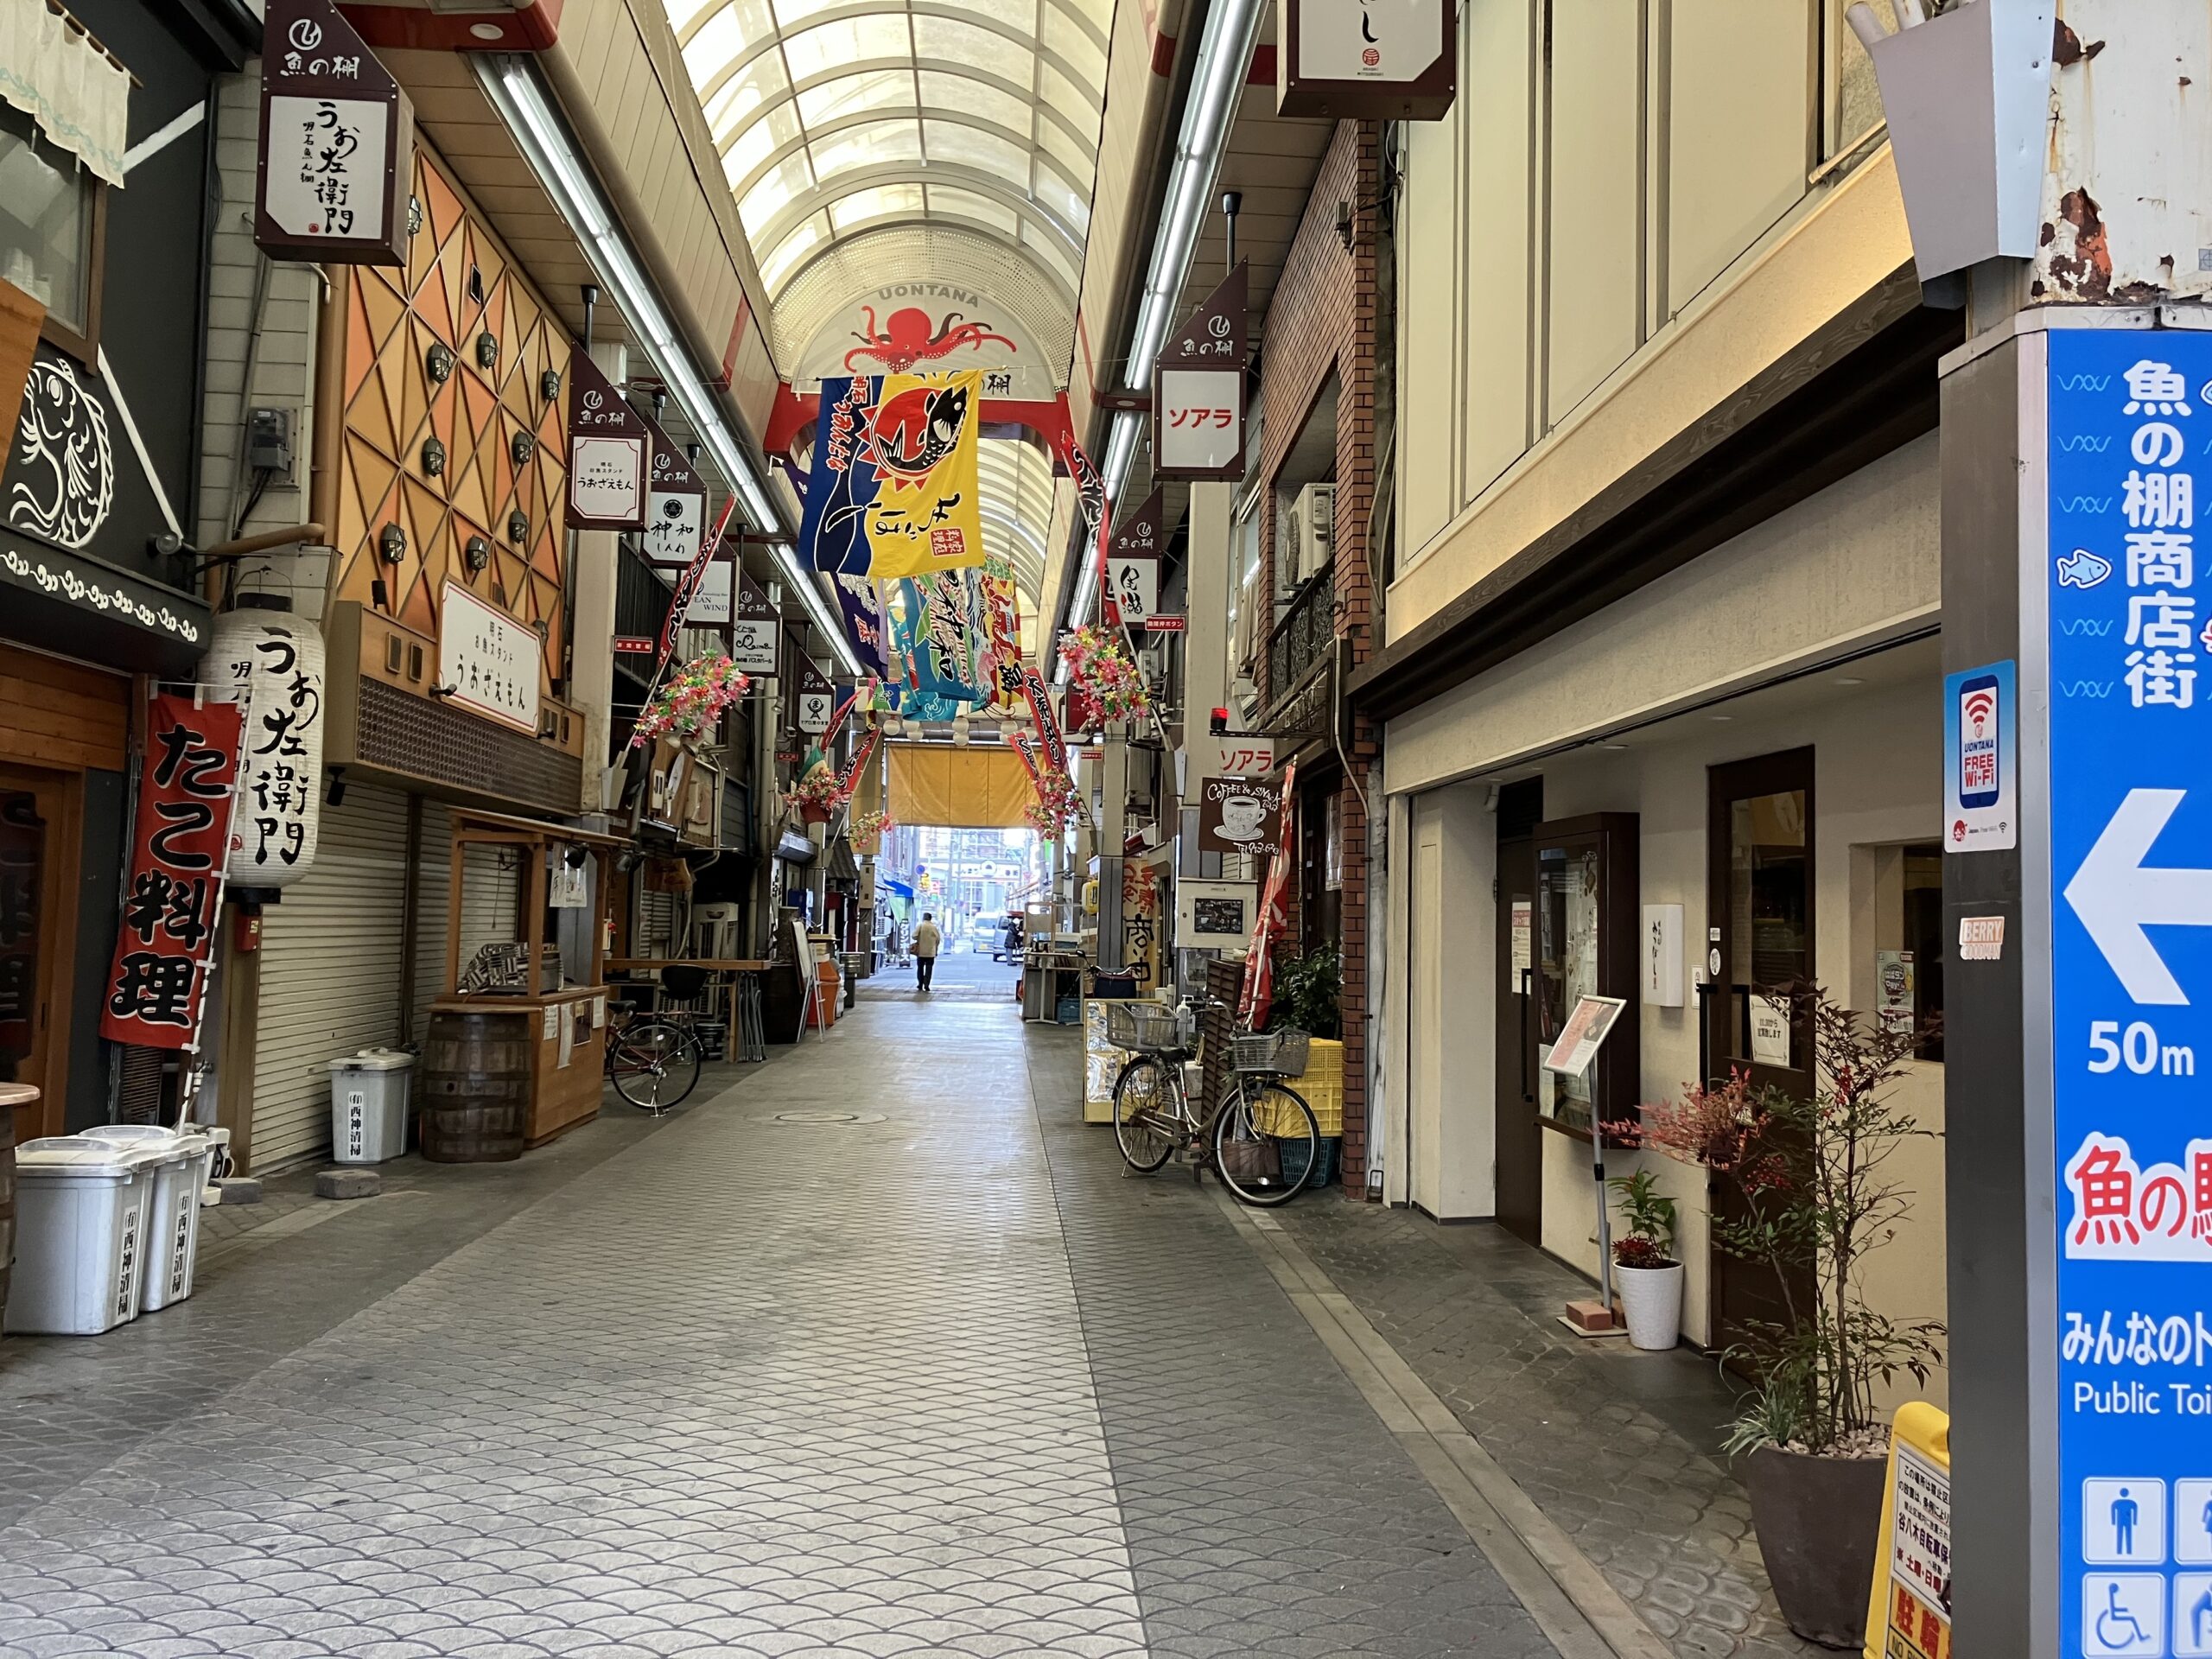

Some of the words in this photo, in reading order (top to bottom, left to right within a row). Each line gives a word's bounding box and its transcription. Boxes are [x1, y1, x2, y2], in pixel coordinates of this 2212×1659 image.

[280, 52, 360, 79] 魚の棚
[314, 102, 360, 234] うお左衛門
[879, 284, 978, 308] UONTANA
[1179, 339, 1234, 358] 魚の棚
[578, 410, 625, 427] 魚の棚
[1169, 409, 1233, 429] ソアラ
[577, 477, 634, 490] うおざえもん
[651, 469, 689, 484] 魚の棚
[651, 520, 694, 540] 神和
[2122, 359, 2197, 709] 魚の棚商店街
[1117, 537, 1154, 550] 魚の棚
[457, 653, 525, 710] うおざえもん
[251, 626, 321, 865] うお左衛門
[1964, 740, 1994, 753] UONTANA
[1221, 750, 1272, 772] ソアラ
[1964, 753, 1993, 770] FREE
[1965, 768, 1994, 787] Wi-Fi
[109, 722, 230, 1027] たこ料理
[1963, 921, 2002, 942] BERRY
[2088, 1020, 2194, 1076] 50m
[2075, 1381, 2160, 1414] Public
